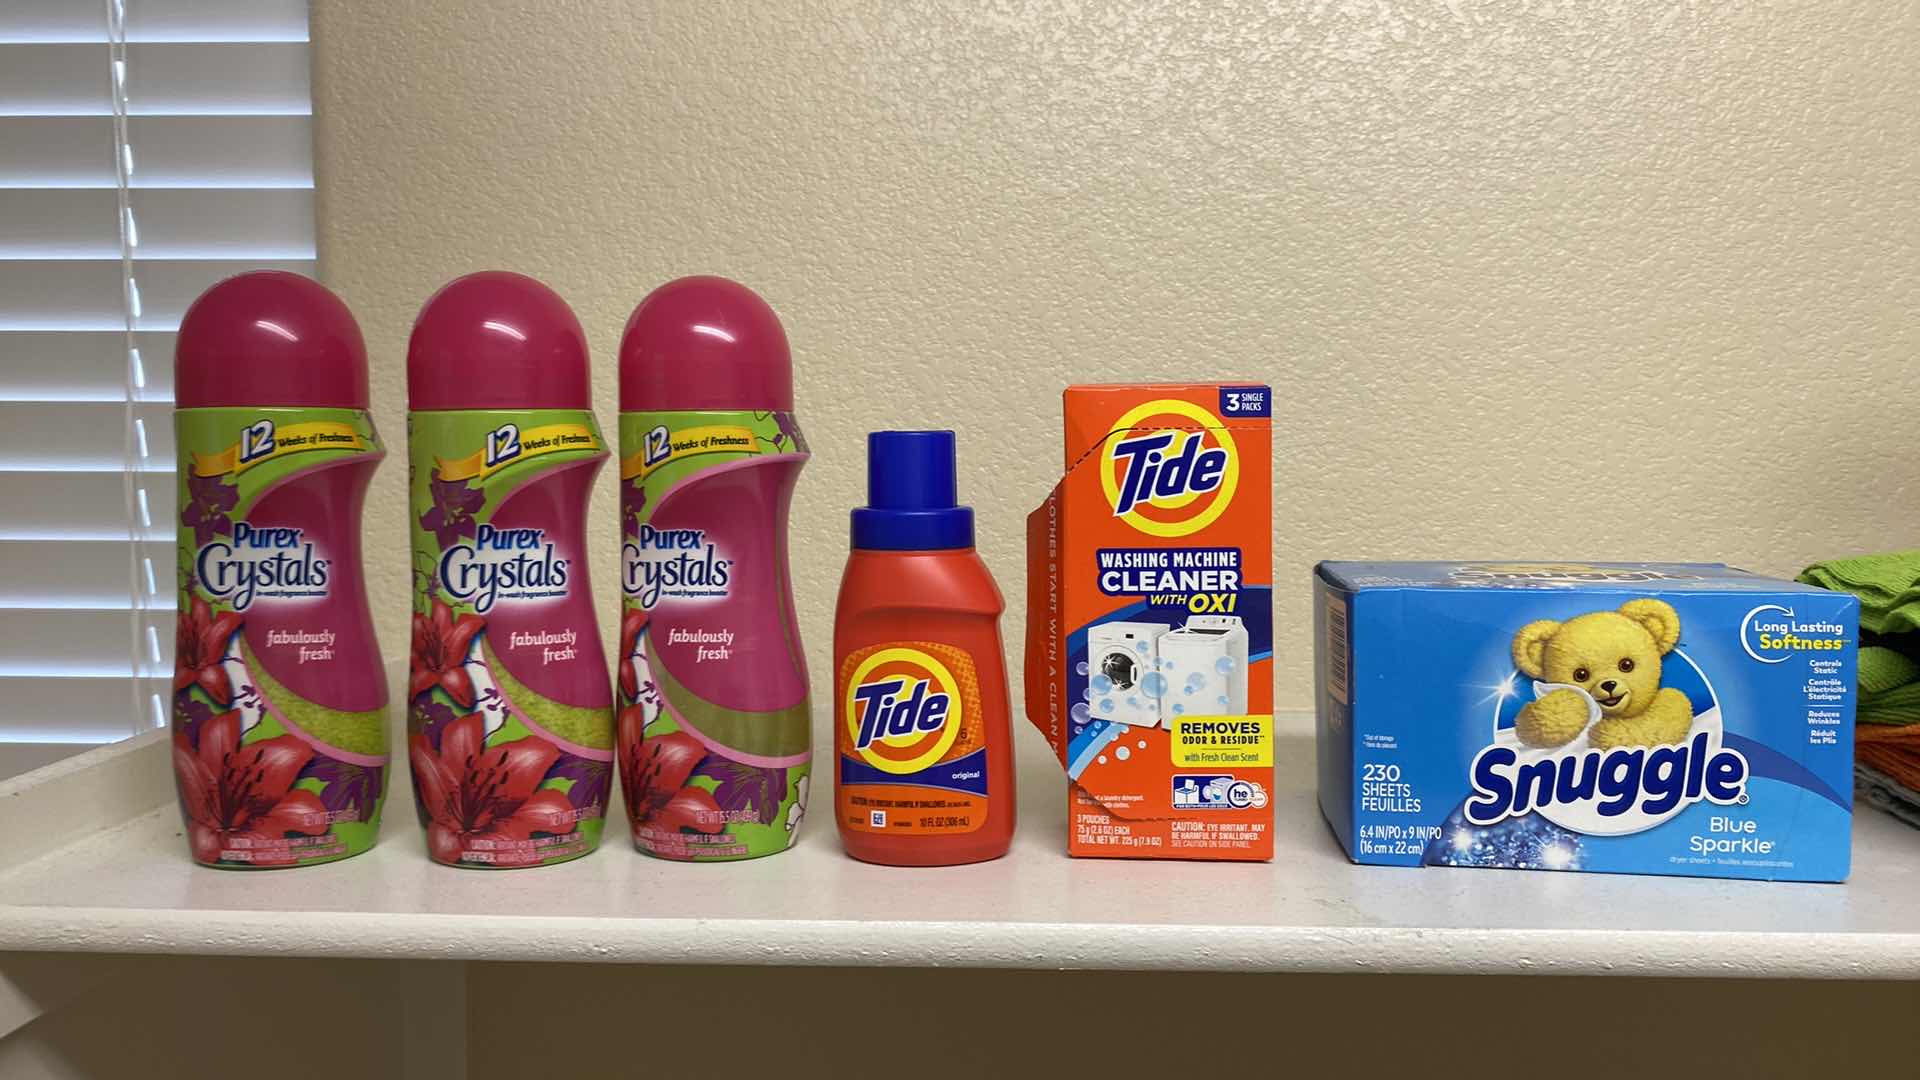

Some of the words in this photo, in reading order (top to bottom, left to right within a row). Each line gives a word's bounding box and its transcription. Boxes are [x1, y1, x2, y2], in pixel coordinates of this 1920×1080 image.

[1226, 393, 1240, 411] 3
[1241, 392, 1264, 402] SINGLE
[1241, 402, 1262, 411] PACKS
[240, 419, 275, 463] 12
[486, 423, 521, 467] 12
[523, 438, 551, 450] Weeks
[552, 436, 561, 447] of
[642, 424, 673, 467] 12
[672, 438, 699, 451] Weeks
[700, 435, 709, 448] of
[710, 435, 750, 446] Freshness
[1112, 431, 1229, 517] Tide
[234, 522, 302, 549] Purex
[477, 524, 542, 551] Purex
[640, 524, 703, 550] Purex
[1101, 552, 1168, 568] WASHING
[1173, 551, 1237, 567] MACHINE
[197, 543, 328, 611] Crystals
[440, 544, 567, 613] Crystals
[622, 544, 729, 608] Crystals
[1102, 570, 1239, 592] CLEANER
[1150, 594, 1187, 605] WITH
[1188, 593, 1237, 613] OXI
[1754, 620, 1788, 634] Long
[1791, 620, 1843, 635] Lasting
[266, 629, 336, 647] fabulously
[509, 628, 577, 650] fabulously
[667, 628, 734, 646] fabulously
[1760, 634, 1842, 650] Softness
[297, 646, 332, 664] fresh
[543, 645, 575, 665] fresh
[696, 645, 729, 663] fresh
[855, 678, 950, 751] Tide
[1808, 717, 1841, 725] Wrinkles
[1181, 722, 1260, 734] REMOVES
[1182, 736, 1207, 745] ODOR
[1211, 736, 1217, 745] &
[1184, 753, 1200, 762] with
[1201, 753, 1220, 762] Fresh
[1221, 753, 1240, 762] Clean
[1241, 753, 1259, 762] Scent
[952, 770, 980, 781] original
[1363, 764, 1401, 782] 230
[1467, 731, 1747, 823] Snuggle
[1234, 788, 1248, 799] he
[1362, 782, 1411, 798] SHEETS
[1361, 797, 1421, 813] FEUILLES
[1083, 814, 1110, 824] POUCHES
[1171, 821, 1206, 832] CAUTION:
[1207, 823, 1218, 832] EYE
[1251, 823, 1266, 832] MAY
[1710, 816, 1757, 833] Blue
[1114, 825, 1131, 835] EACH
[1181, 831, 1210, 840] HARMFUL
[1360, 824, 1374, 839] 6.4
[1375, 825, 1401, 840] IN/PO
[1402, 829, 1408, 839] x
[1408, 826, 1415, 839] 9
[1416, 826, 1442, 840] IN/PO
[1360, 839, 1373, 855] (16
[1374, 844, 1387, 854] cm
[1395, 841, 1406, 854] 22
[1407, 840, 1424, 856] cm)
[1689, 835, 1773, 856] Sparkle
